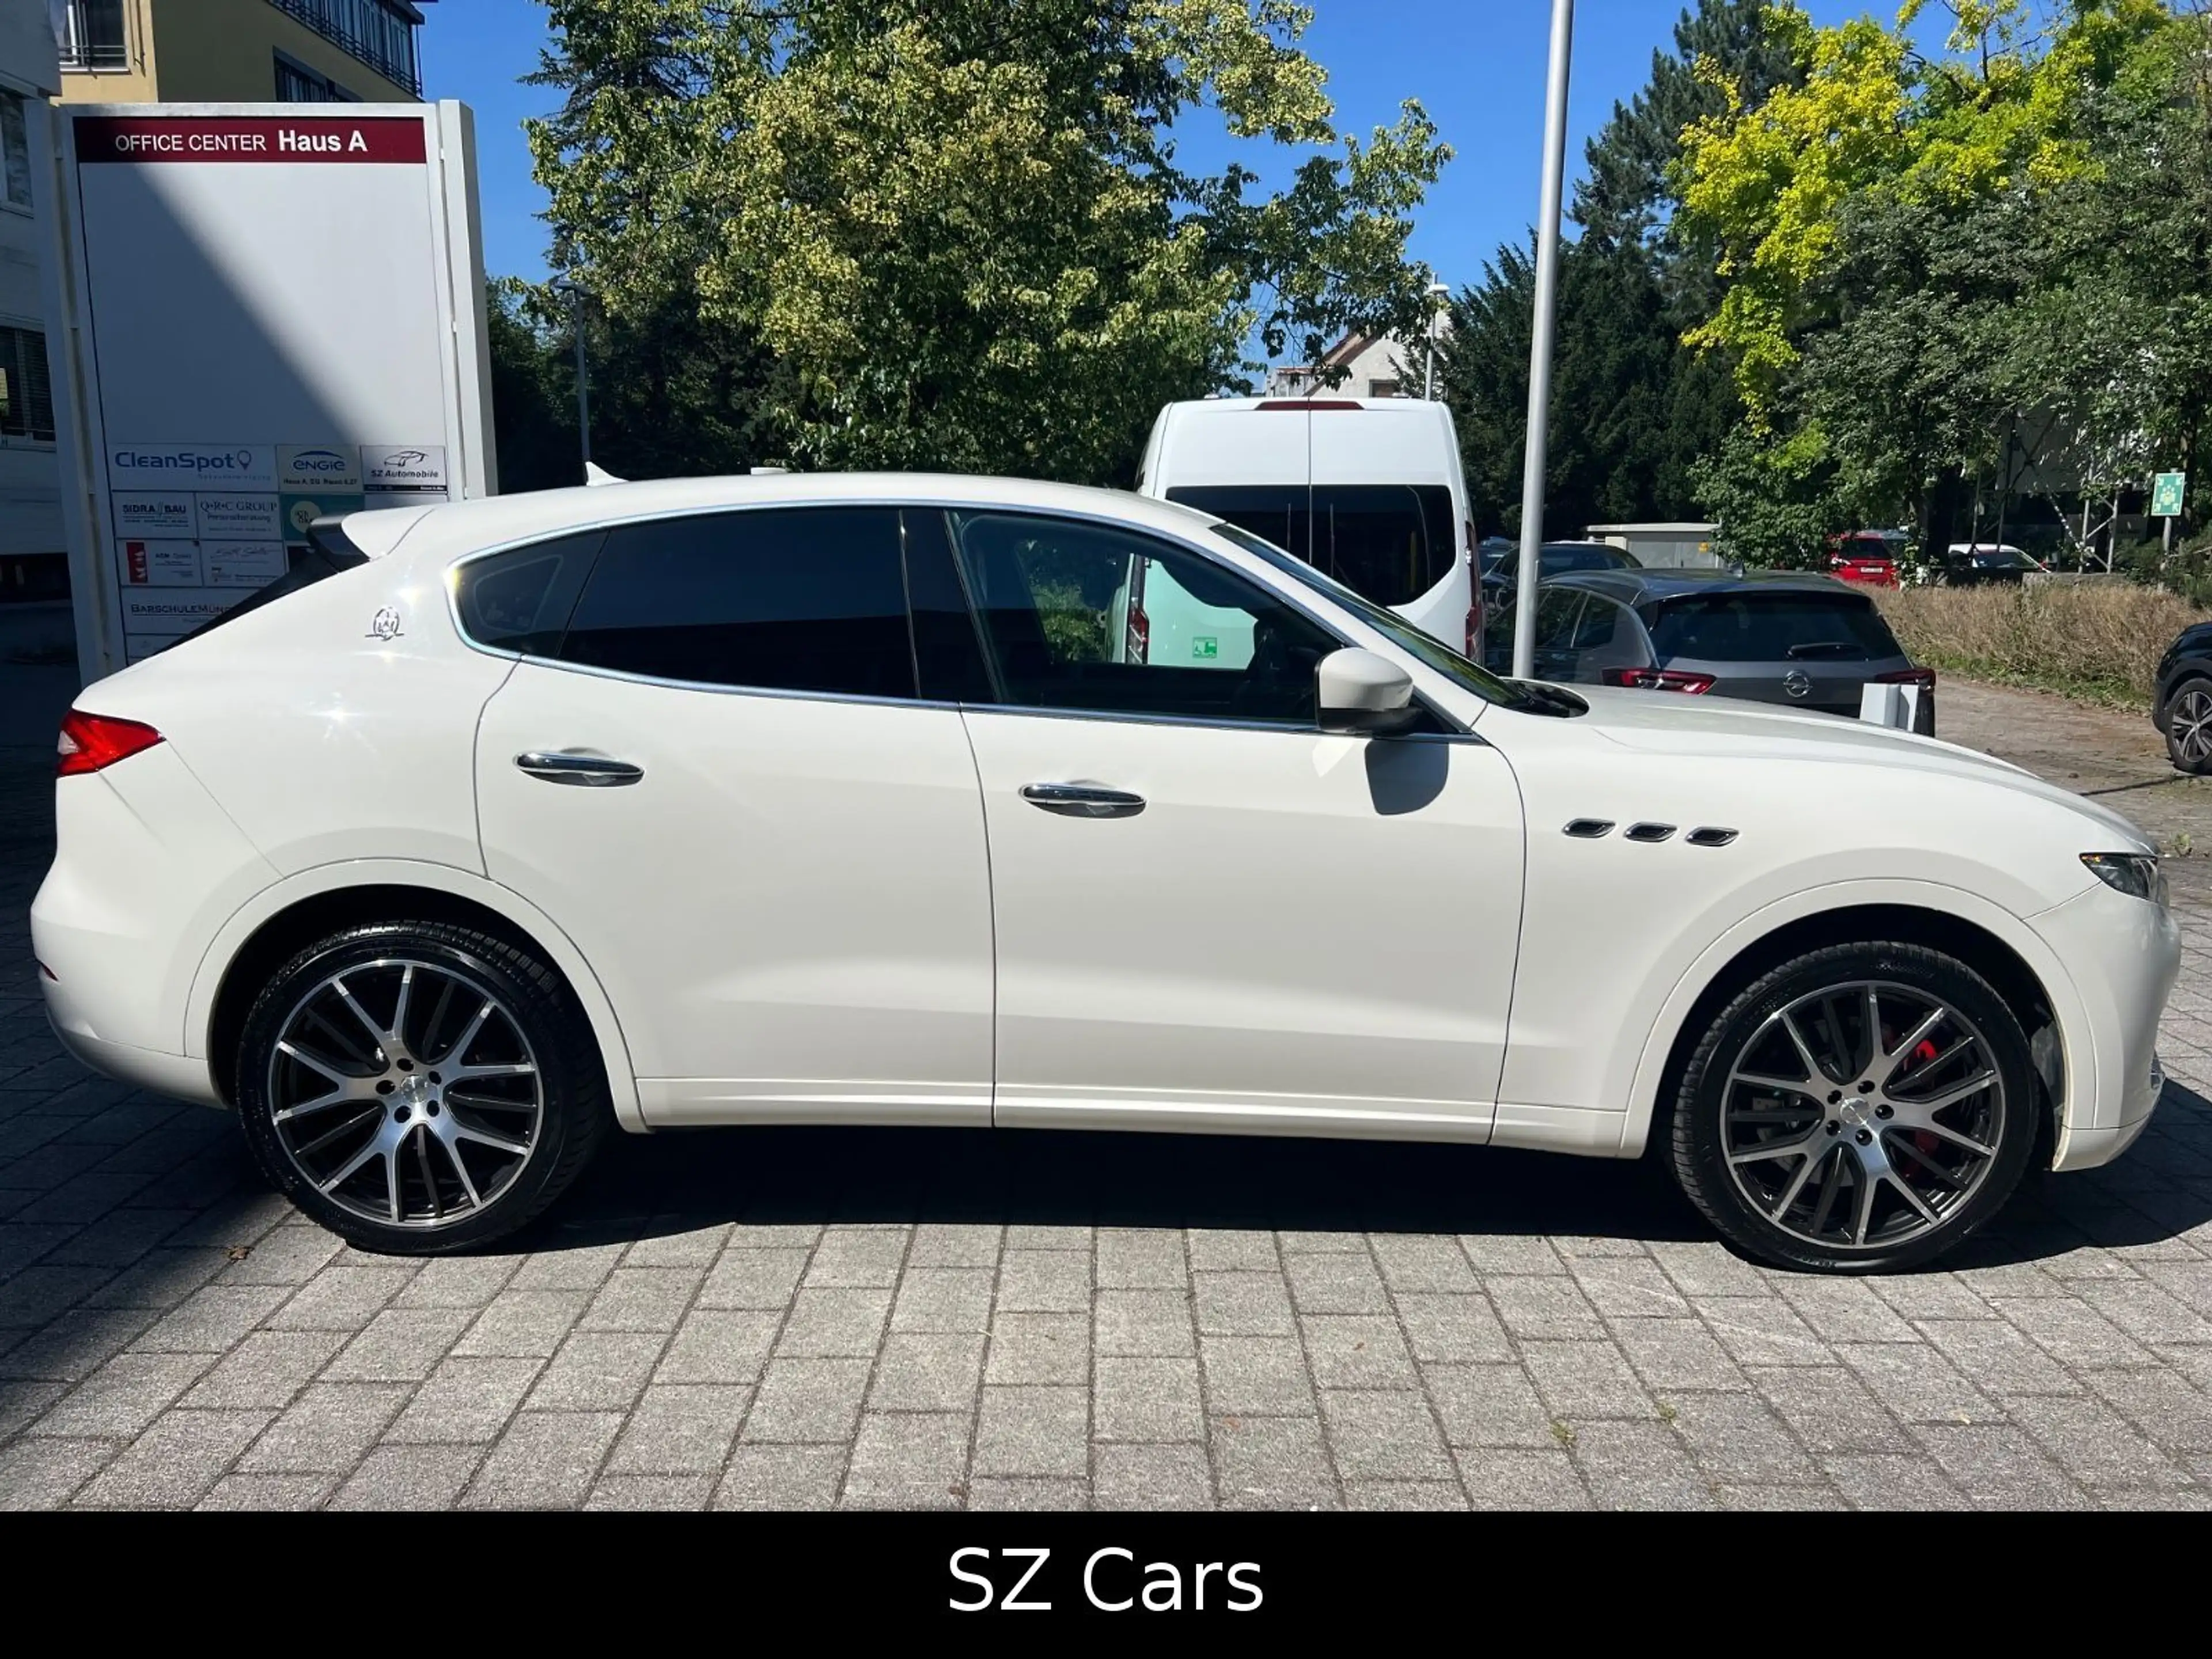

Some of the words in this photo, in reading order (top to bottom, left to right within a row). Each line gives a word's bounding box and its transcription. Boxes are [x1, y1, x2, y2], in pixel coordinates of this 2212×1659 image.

[115, 134, 183, 151] OFFICE
[189, 134, 267, 151] CENTER
[278, 130, 342, 152] Haus
[348, 130, 368, 152] A
[115, 452, 235, 472] CleanSpot
[371, 469, 383, 478] SZ
[385, 469, 438, 478] Automobile
[122, 504, 156, 513] SIDRA
[164, 505, 186, 514] BAU
[236, 501, 278, 512] GROUP
